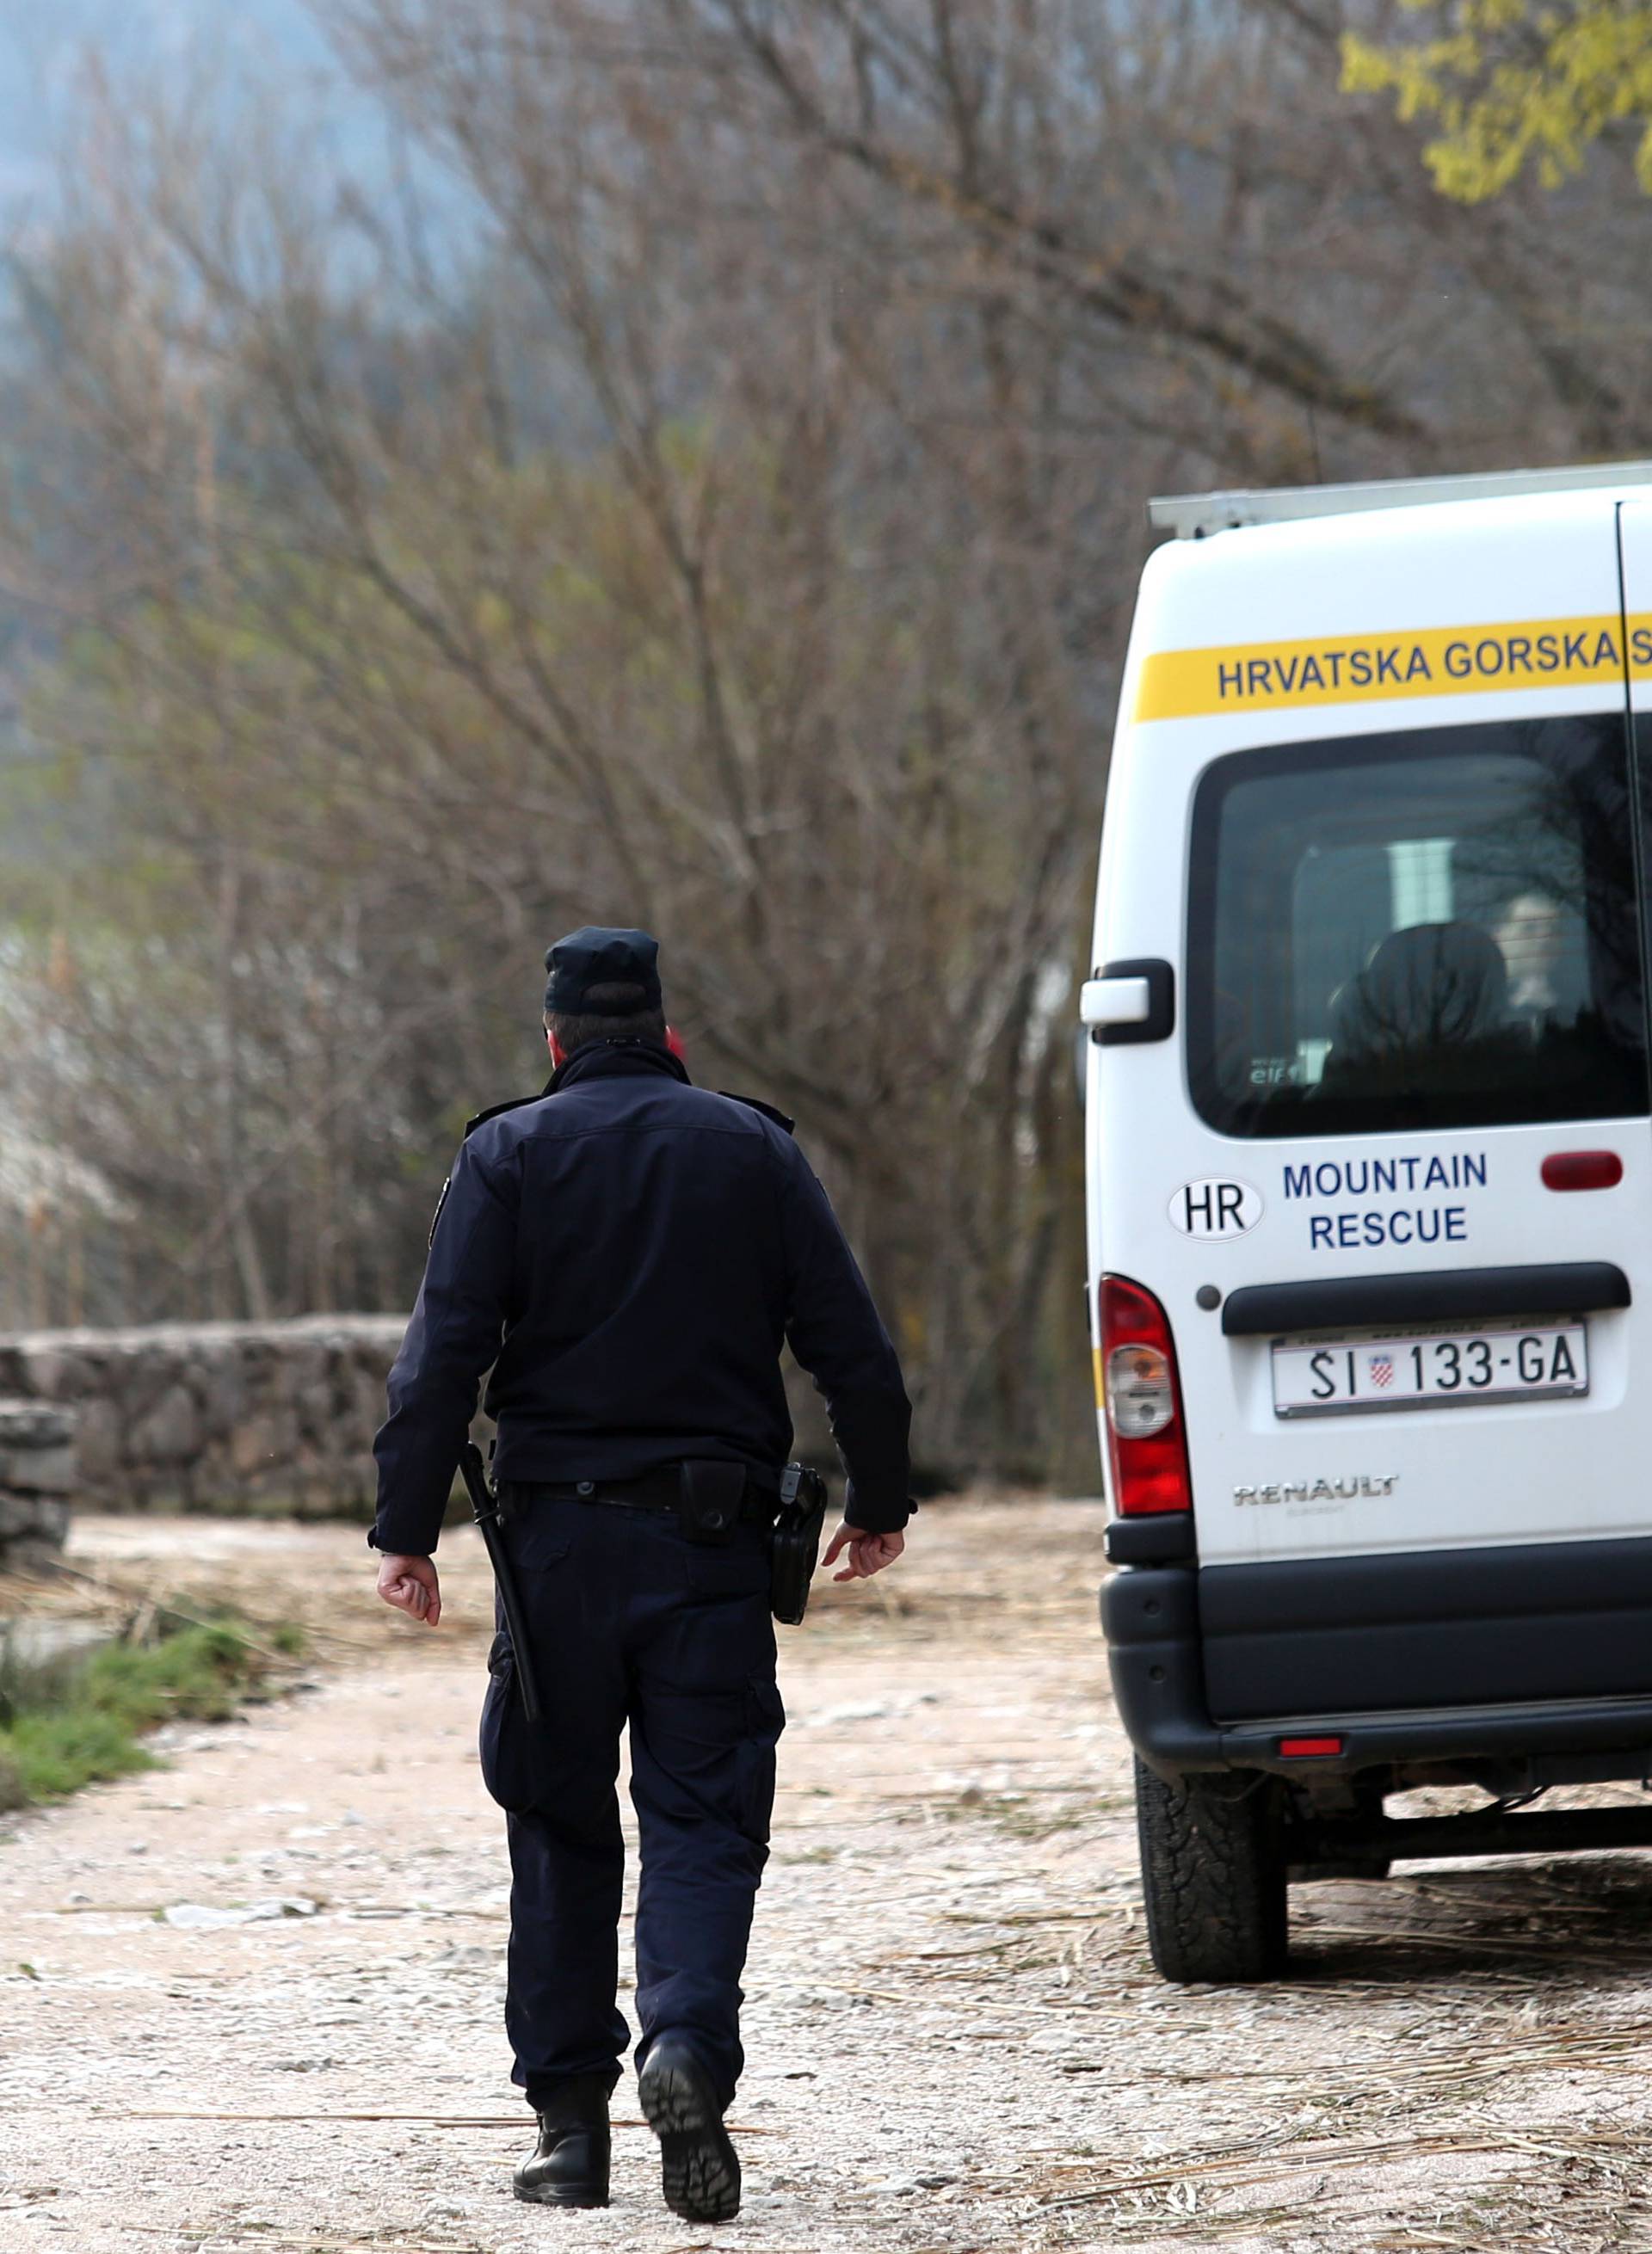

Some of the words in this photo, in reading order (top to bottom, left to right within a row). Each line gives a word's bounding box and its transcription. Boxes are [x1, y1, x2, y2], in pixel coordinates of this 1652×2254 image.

[1218, 646, 1432, 699] HRVATSKA
[1444, 631, 1620, 678] GORSKA
[1283, 1153, 1488, 1199] MOUNTAIN
[1183, 1183, 1246, 1233] HR
[1310, 1207, 1468, 1250] RESCUE
[1410, 1334, 1577, 1392] 133-GA
[1232, 1474, 1400, 1506] RENAULT
